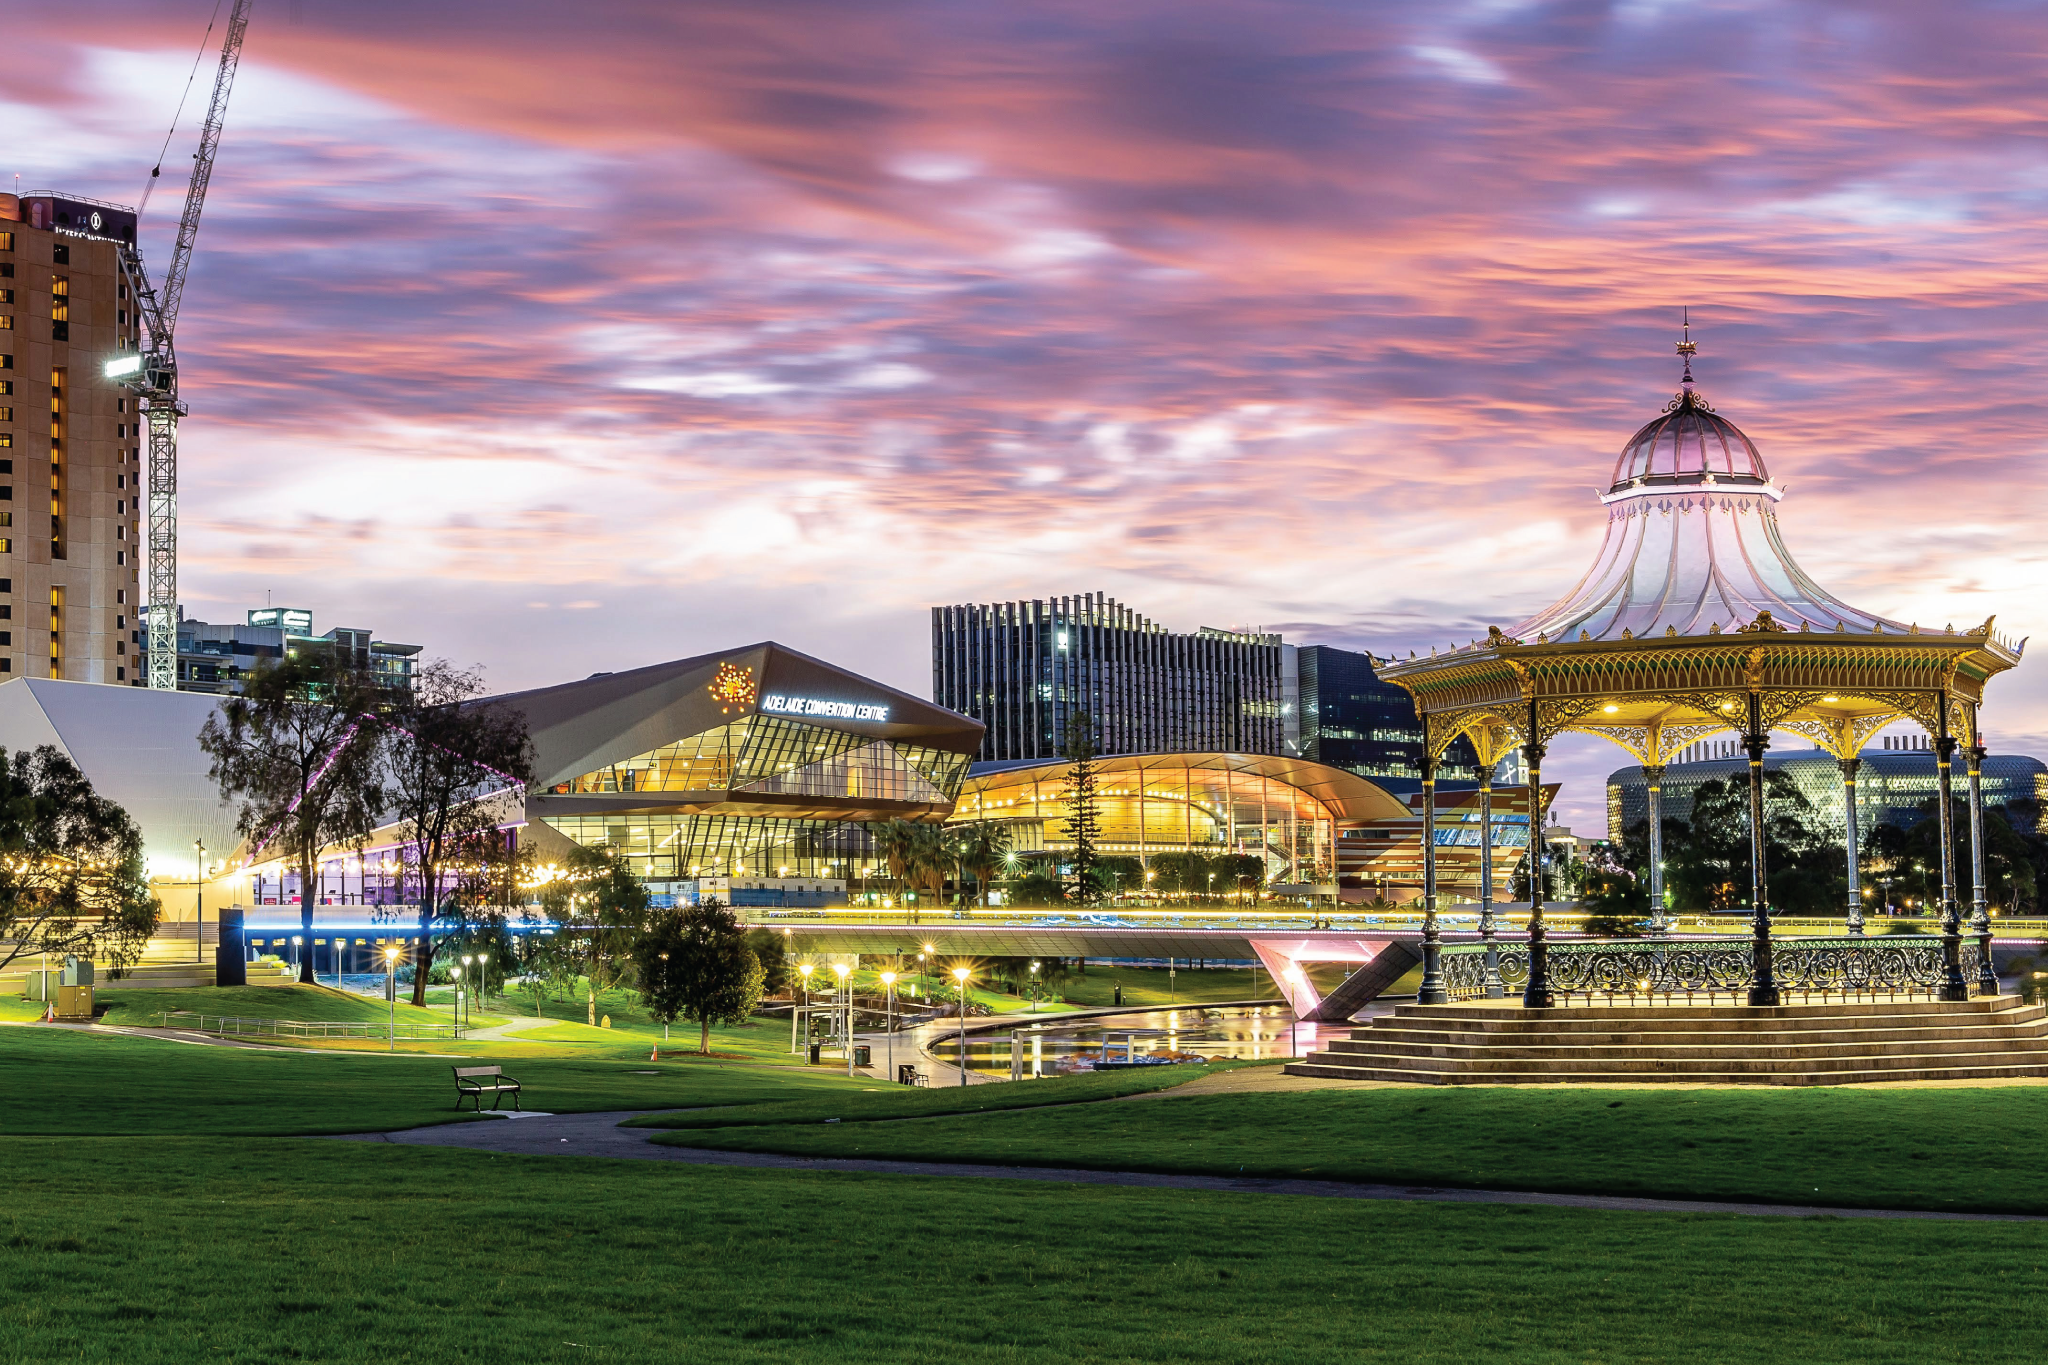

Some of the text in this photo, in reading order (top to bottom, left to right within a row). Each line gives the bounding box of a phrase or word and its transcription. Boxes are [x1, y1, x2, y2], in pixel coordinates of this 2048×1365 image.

[763, 695, 889, 722] ADELAIDE CONVENTION CENTRE
